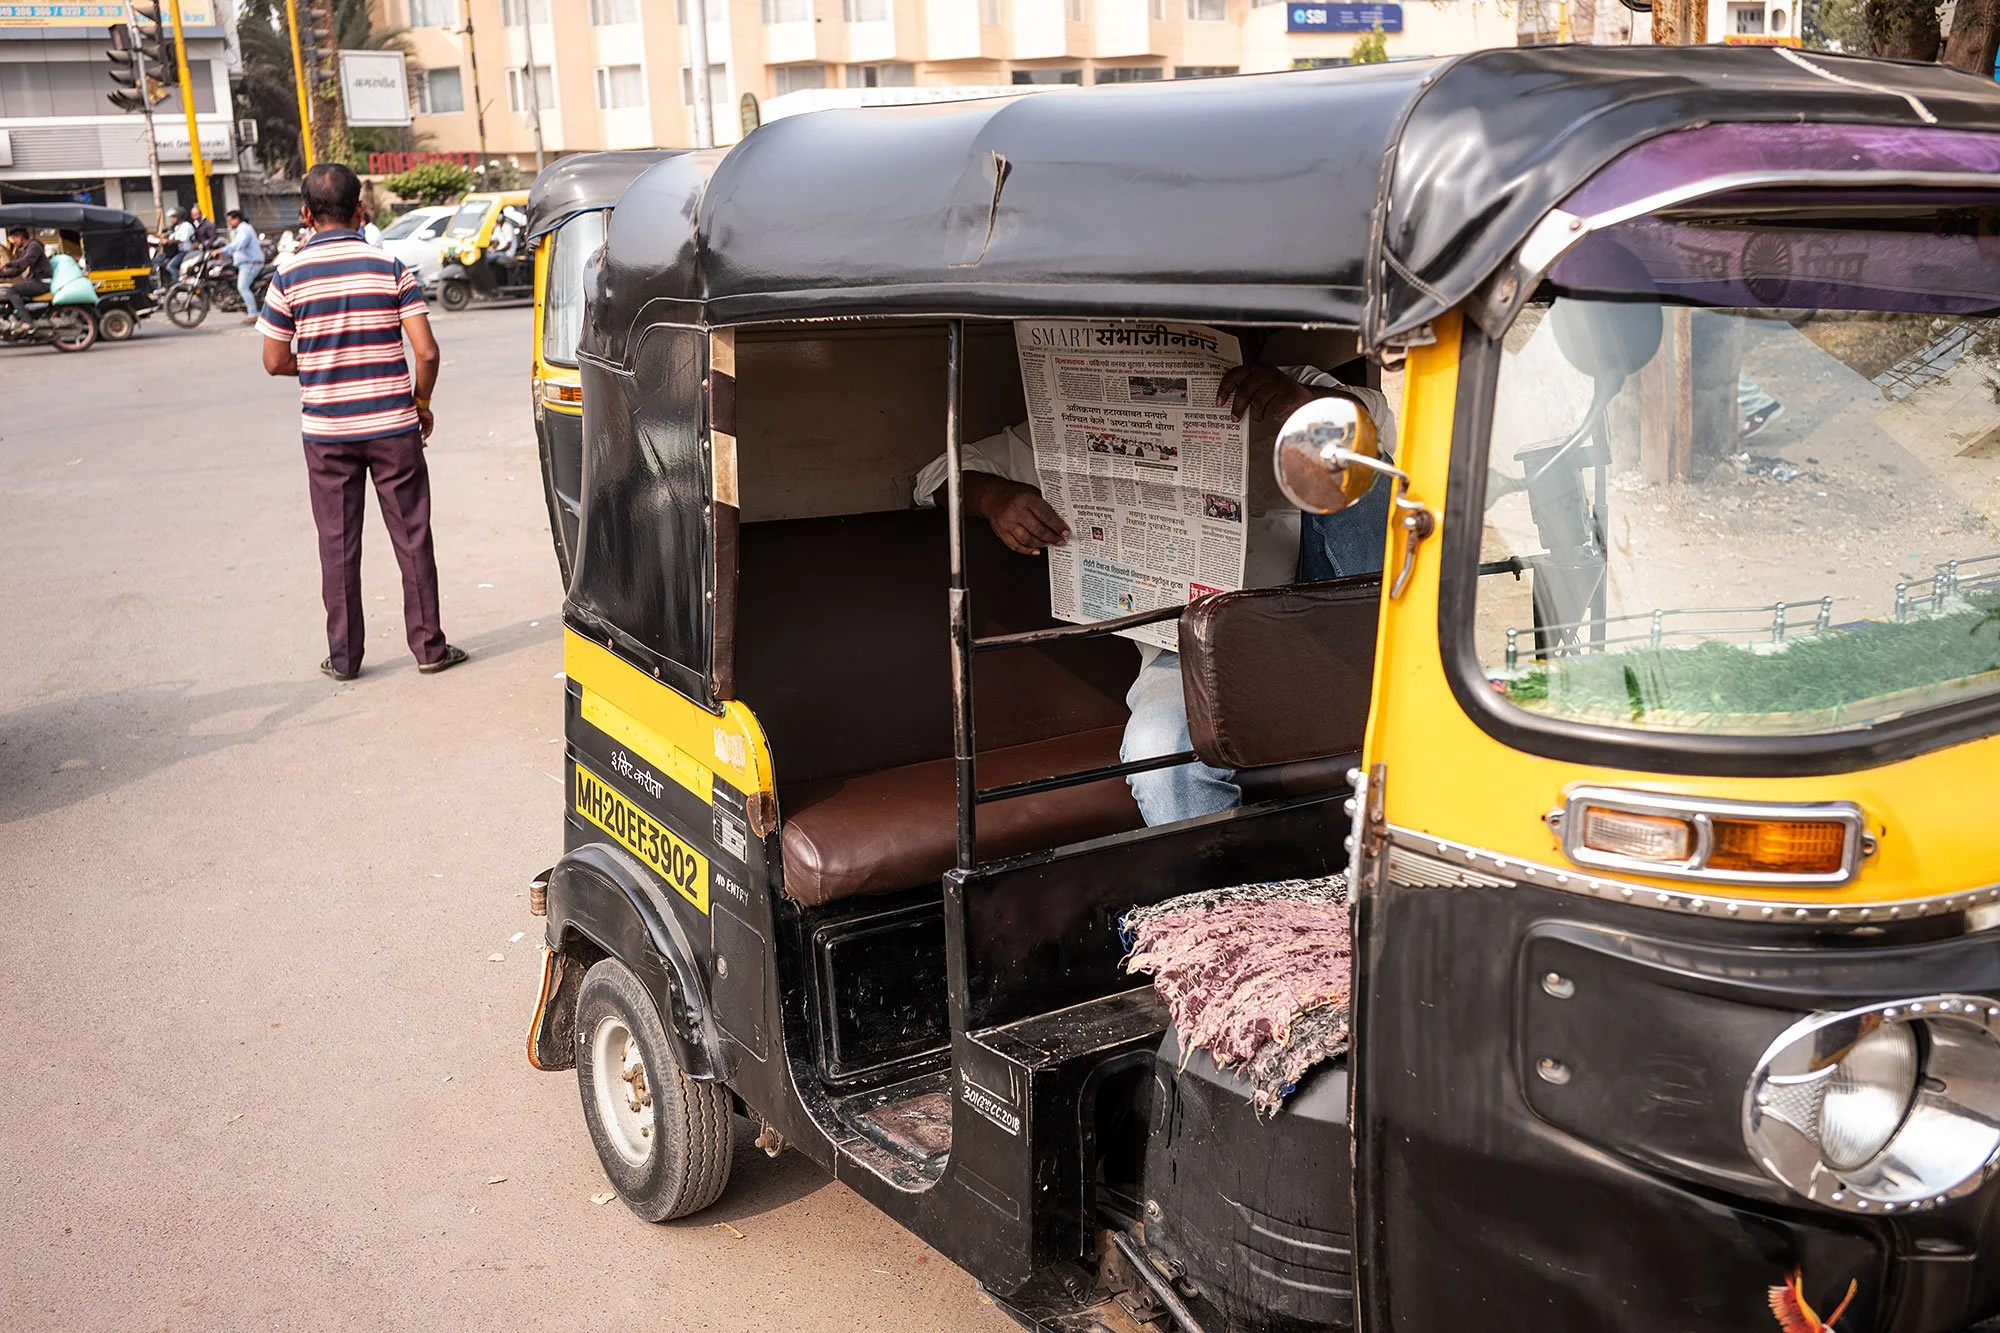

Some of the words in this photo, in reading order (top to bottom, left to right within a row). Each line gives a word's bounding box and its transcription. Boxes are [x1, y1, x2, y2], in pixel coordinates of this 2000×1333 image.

[1306, 9, 1327, 24] SBI
[1031, 327, 1095, 347] SMART
[1095, 323, 1219, 354] संभाजीनगर
[1066, 404, 1101, 415] अतिक्रमण
[1061, 413, 1088, 424] निश्चित
[1090, 415, 1105, 426] केले
[1155, 420, 1175, 431] धोरण
[617, 750, 633, 779] सिट
[633, 768, 665, 799] करीता
[726, 878, 749, 907] ENTRY
